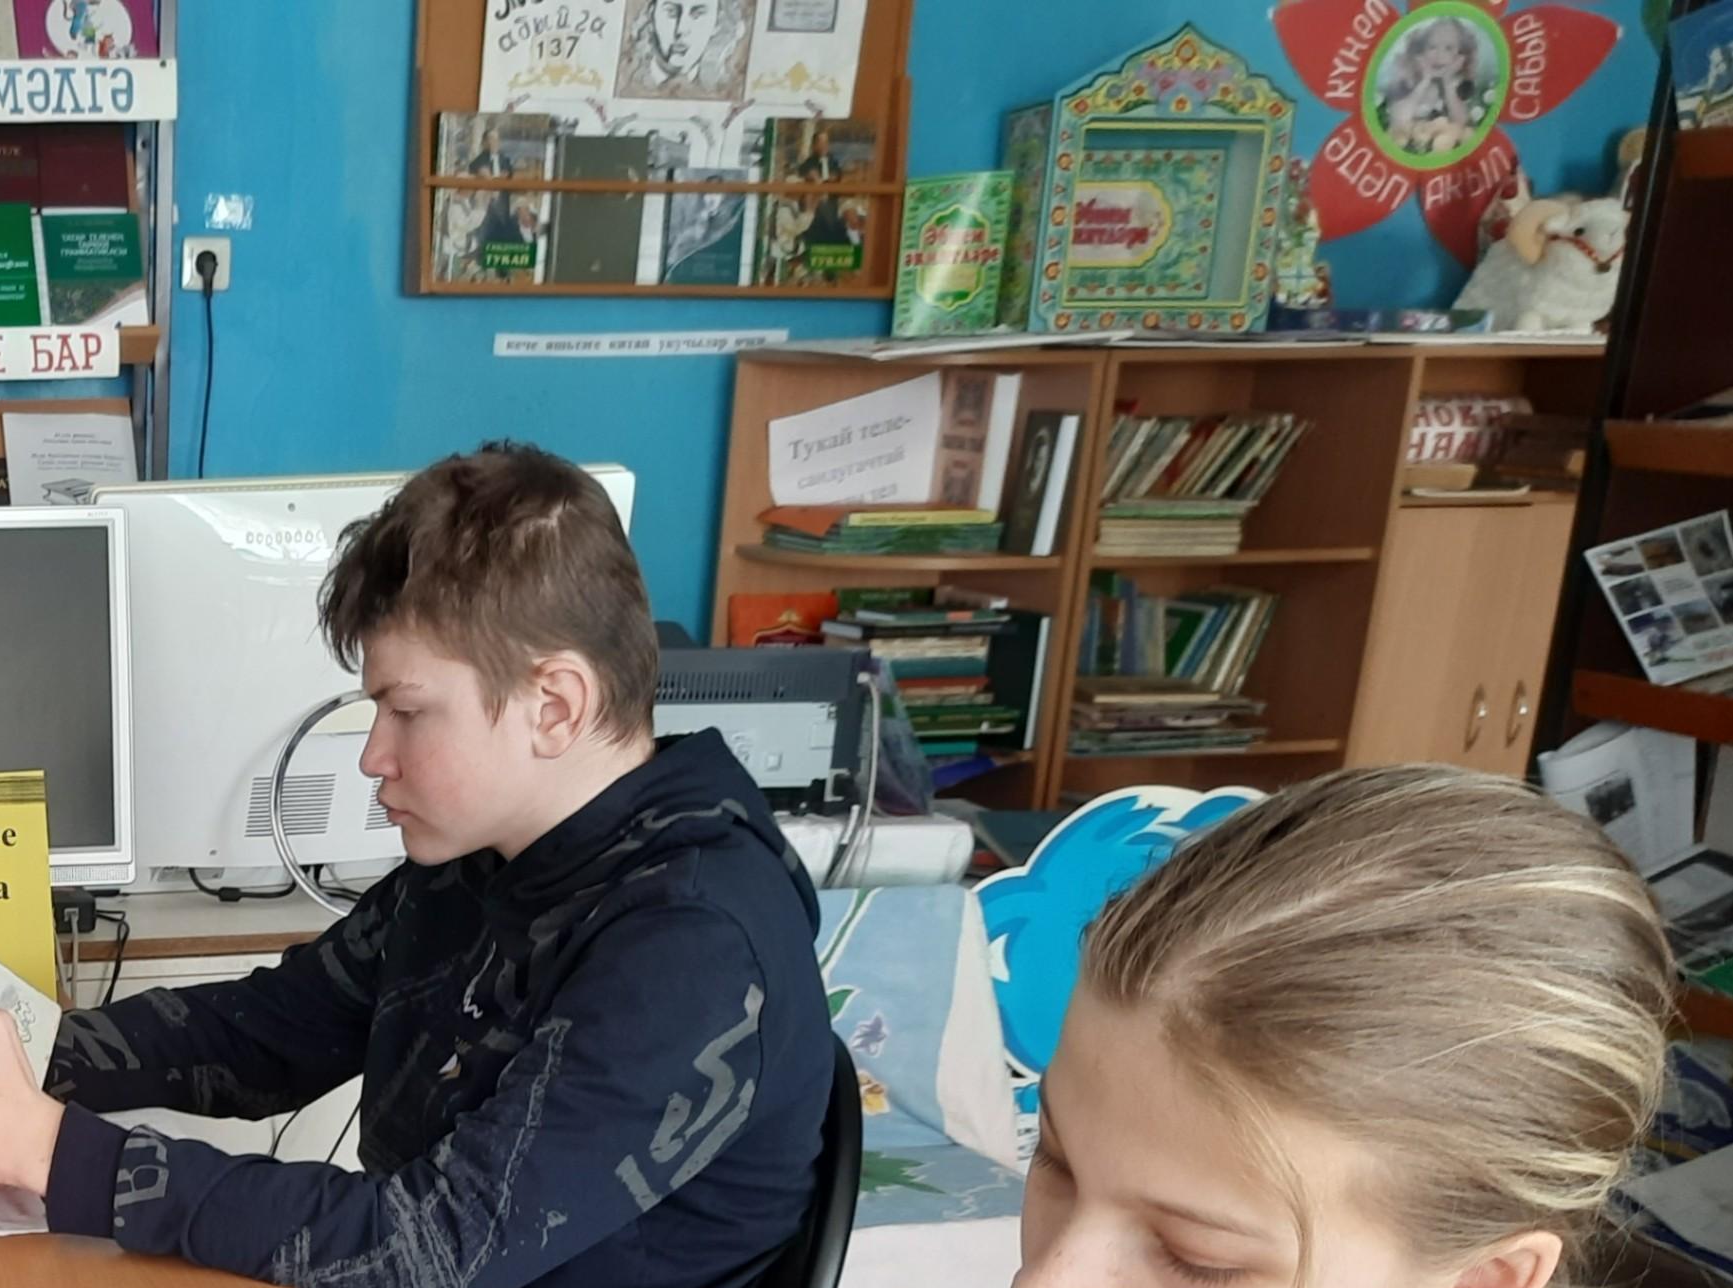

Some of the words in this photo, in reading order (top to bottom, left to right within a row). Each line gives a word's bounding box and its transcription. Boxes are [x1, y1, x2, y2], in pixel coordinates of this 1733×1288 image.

[535, 35, 580, 60] 137
[31, 332, 103, 374] БАР
[788, 428, 853, 462] Тукай
